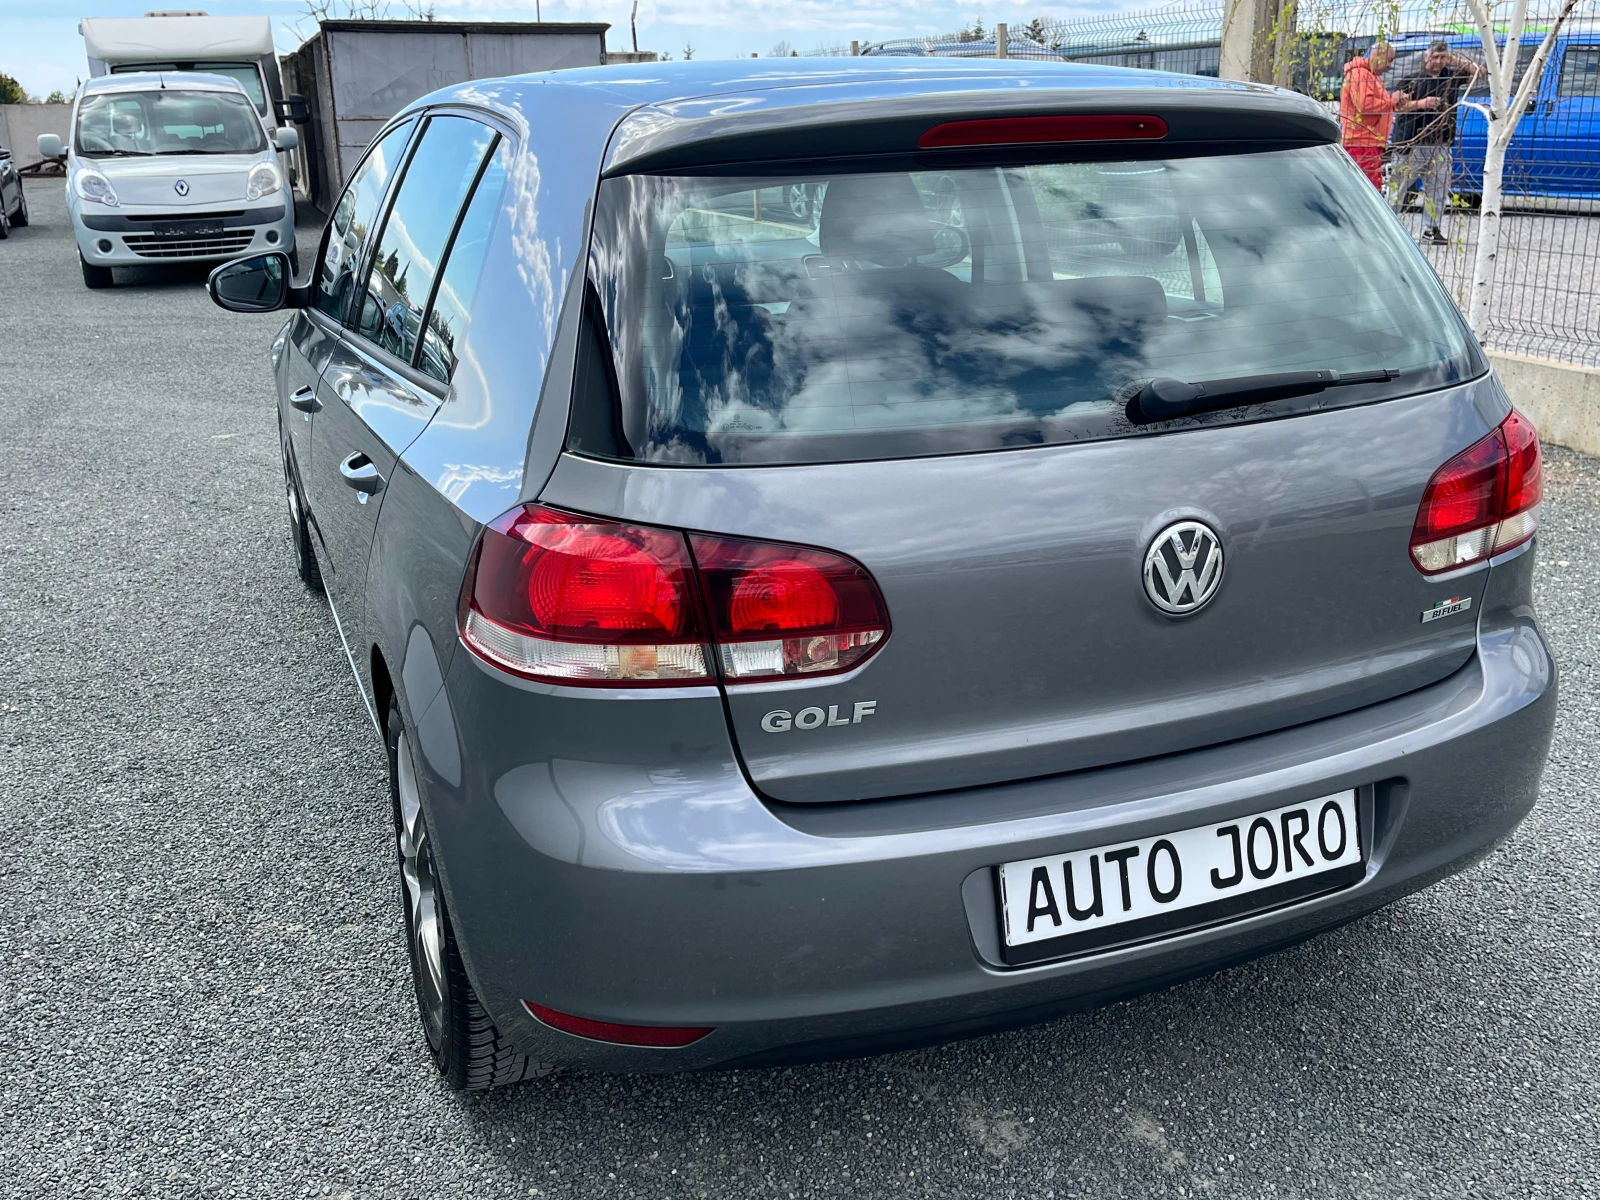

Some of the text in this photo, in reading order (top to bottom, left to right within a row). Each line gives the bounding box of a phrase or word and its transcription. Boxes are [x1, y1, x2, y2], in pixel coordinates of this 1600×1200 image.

[1144, 521, 1223, 613] VW
[761, 700, 877, 733] GOLF
[1026, 800, 1347, 933] AUTO JORO
